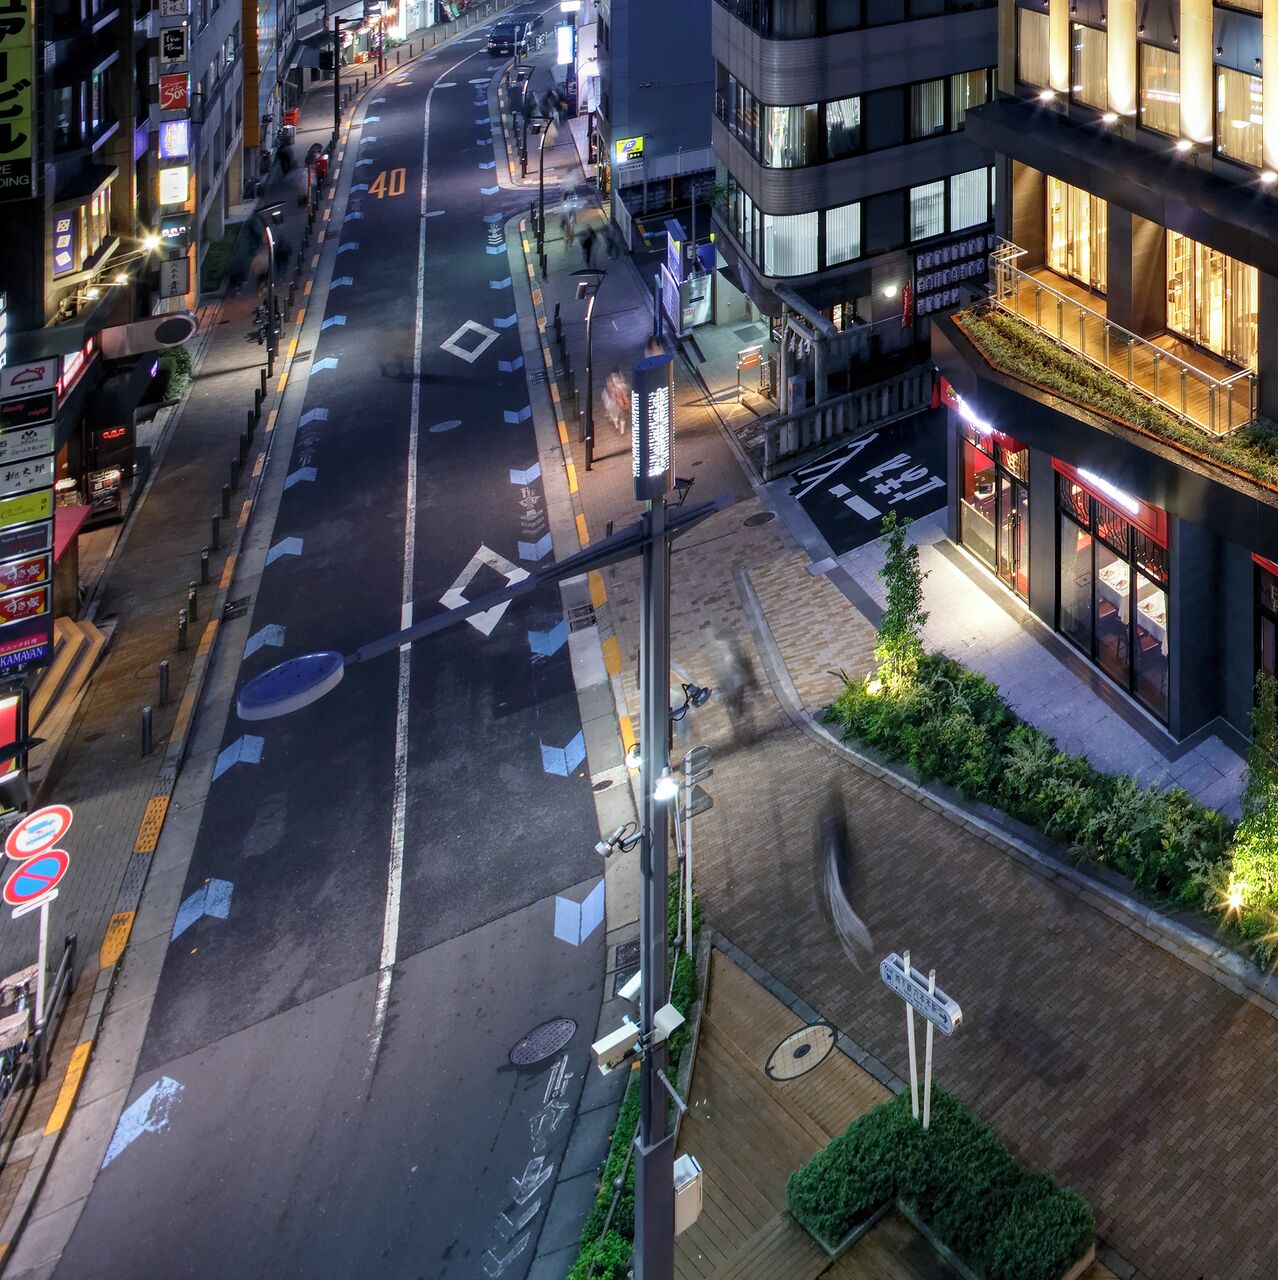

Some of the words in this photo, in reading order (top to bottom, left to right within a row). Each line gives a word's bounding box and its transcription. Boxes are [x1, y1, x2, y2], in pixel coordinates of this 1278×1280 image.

[368, 168, 406, 199] 40
[859, 453, 946, 505] 止まれ
[5, 564, 40, 580] すき家
[5, 596, 40, 613] すき家
